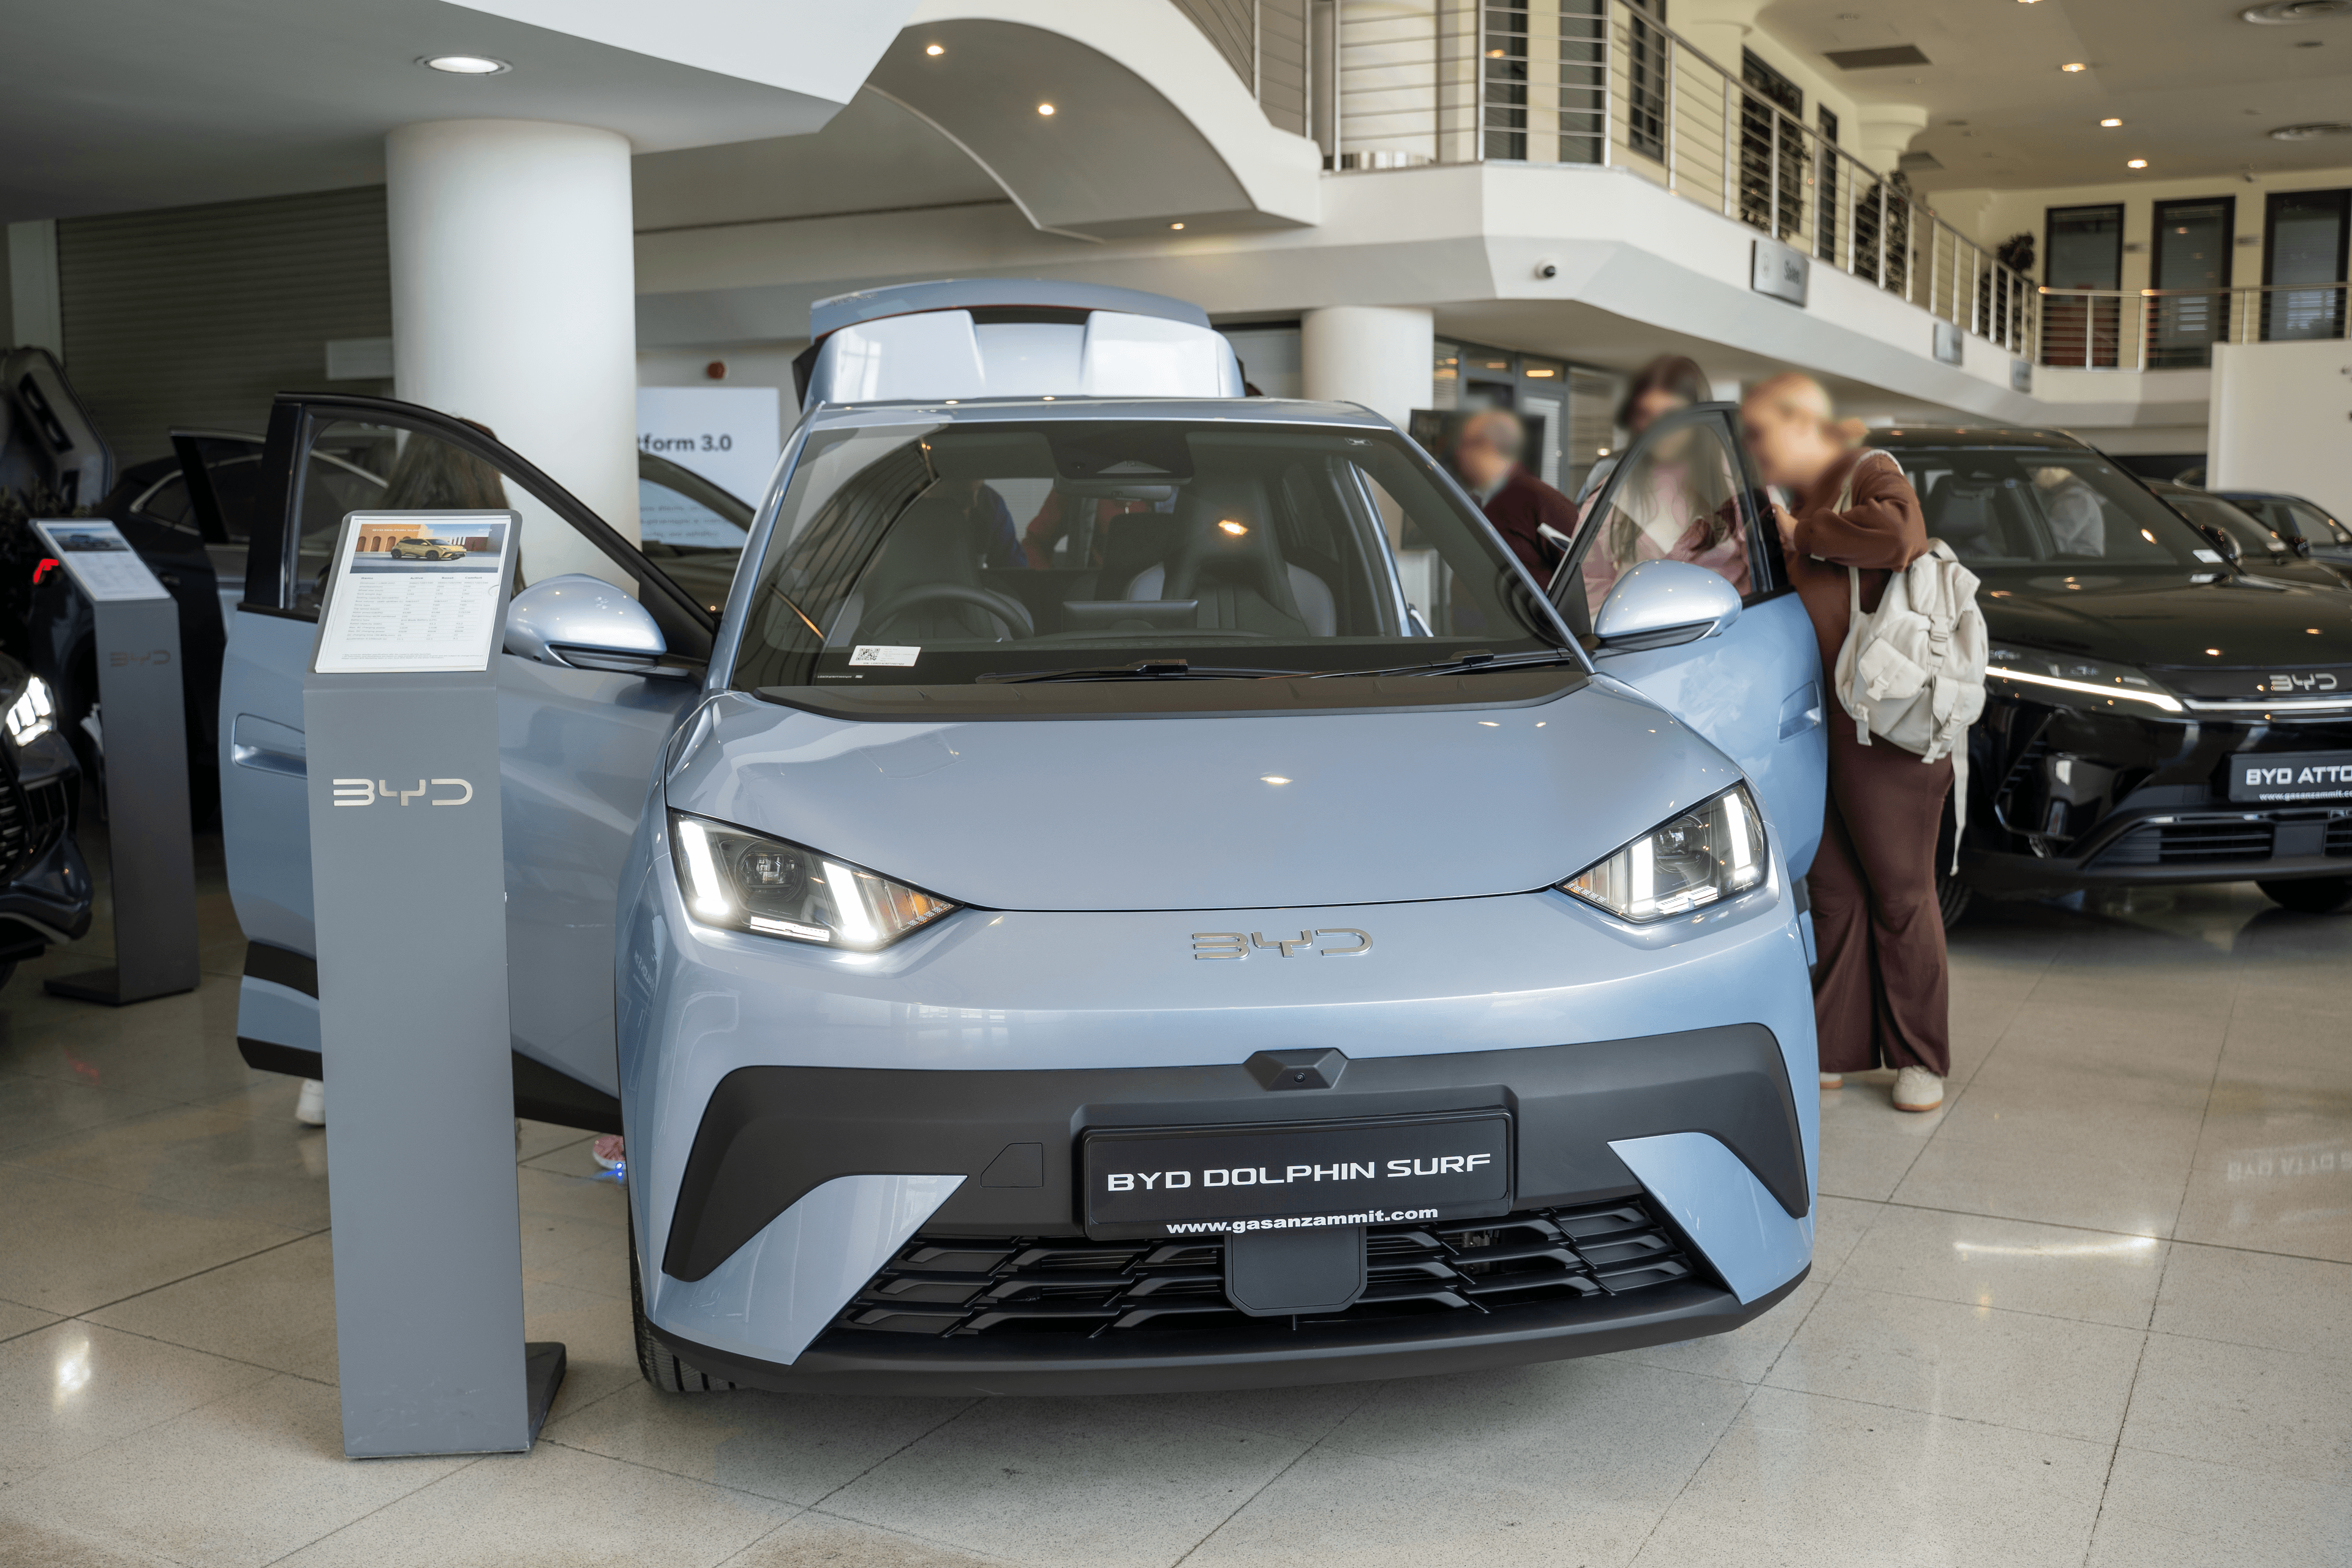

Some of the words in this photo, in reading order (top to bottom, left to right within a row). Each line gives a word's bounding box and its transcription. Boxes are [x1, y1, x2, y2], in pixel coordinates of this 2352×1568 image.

[701, 434, 732, 451] 3.0
[110, 650, 170, 666] BYD
[2269, 673, 2338, 692] BYD
[2246, 767, 2293, 785] BYD
[2297, 765, 2352, 784] ATTO
[333, 778, 473, 806] BYD
[1192, 928, 1373, 960] BYD
[1107, 1171, 1191, 1191] BYD
[1204, 1161, 1375, 1187] DOLPHIN
[1387, 1153, 1491, 1178] SURF
[1166, 1207, 1438, 1234] www.gasanzammit.com
